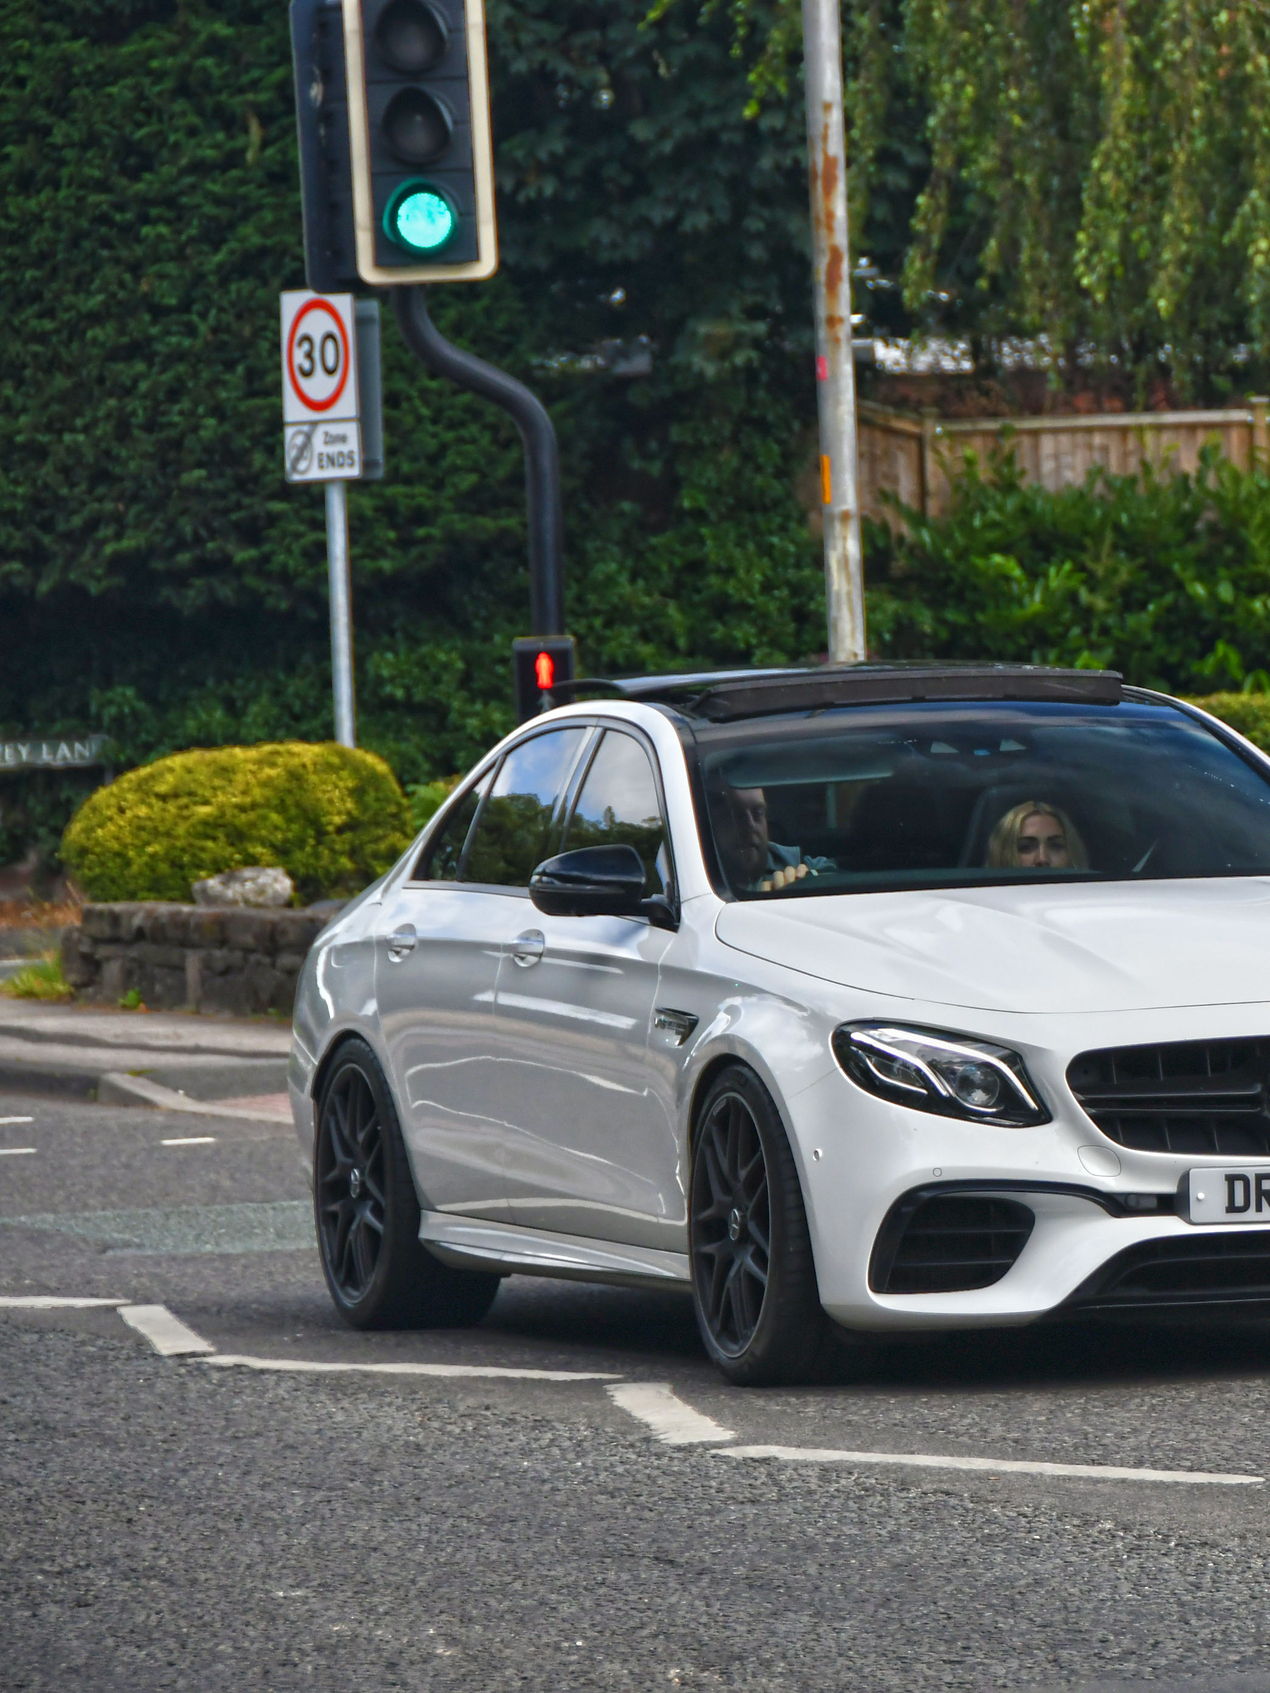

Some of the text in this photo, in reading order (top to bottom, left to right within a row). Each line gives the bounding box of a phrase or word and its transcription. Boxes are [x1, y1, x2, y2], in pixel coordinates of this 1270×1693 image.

[297, 332, 340, 378] 30
[323, 431, 348, 445] Zone
[317, 450, 356, 469] ENDS
